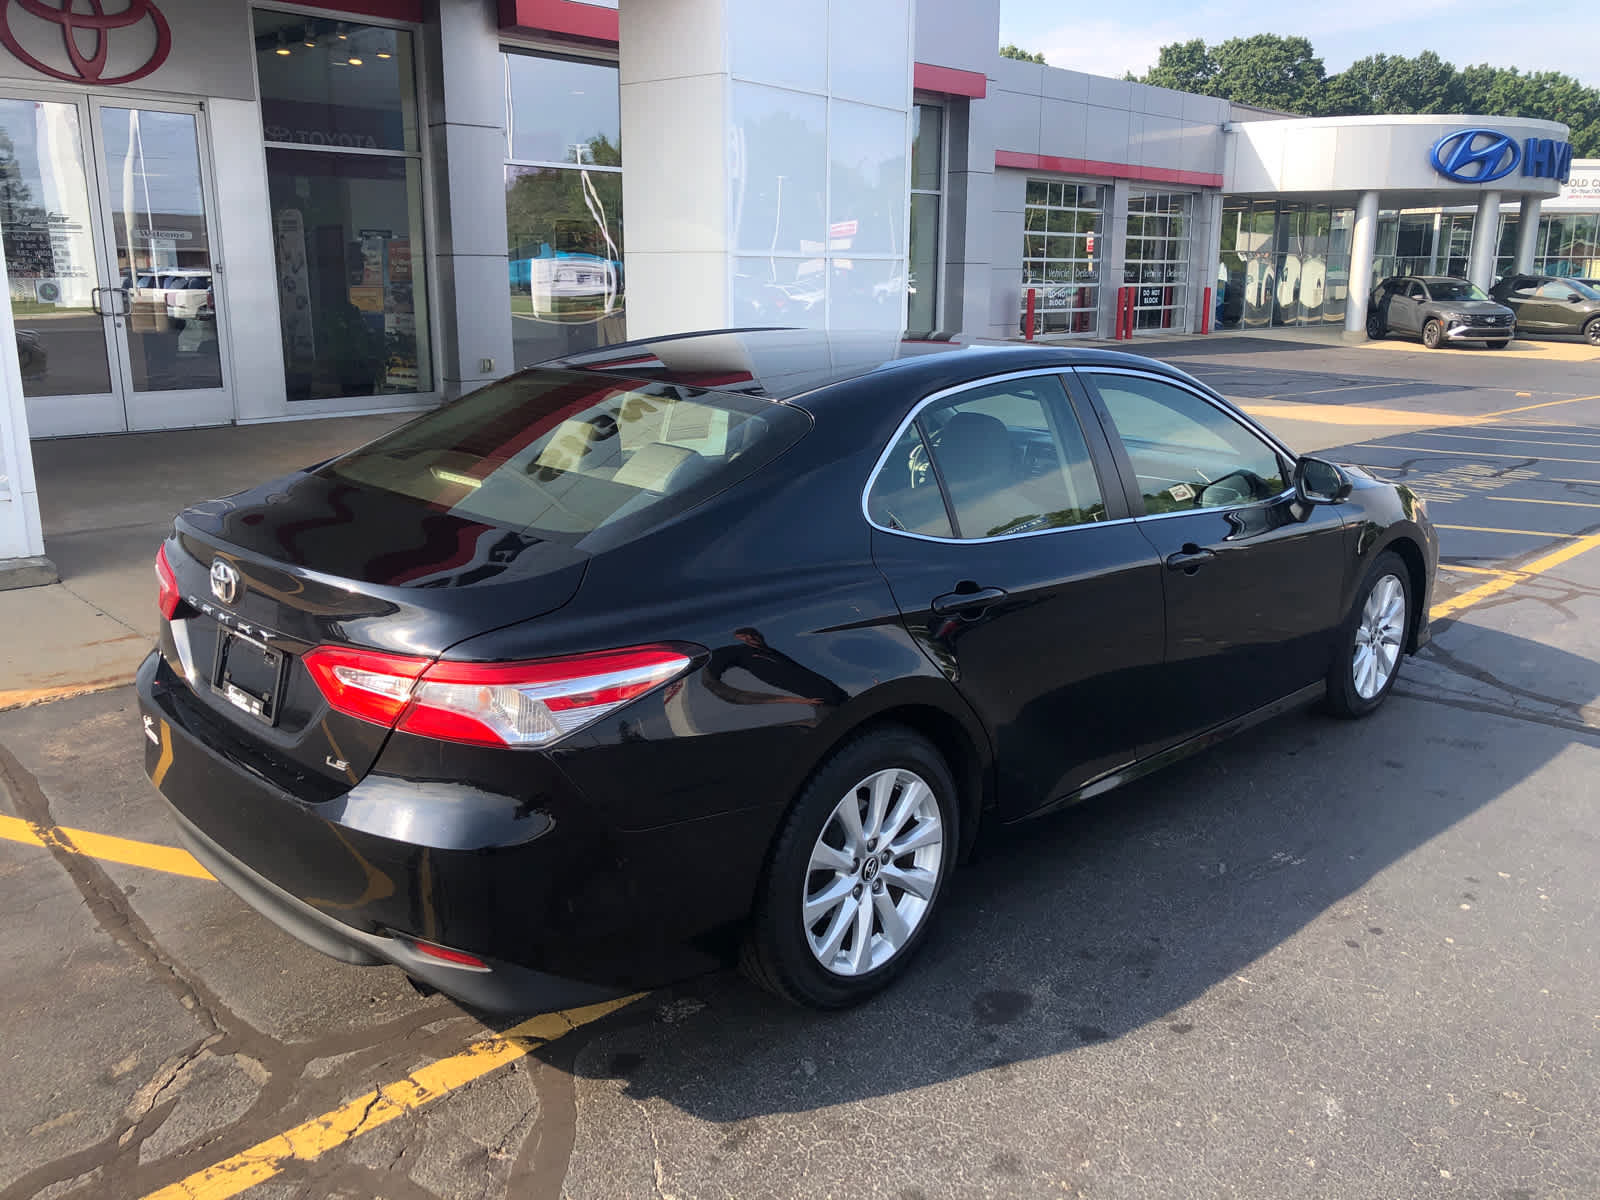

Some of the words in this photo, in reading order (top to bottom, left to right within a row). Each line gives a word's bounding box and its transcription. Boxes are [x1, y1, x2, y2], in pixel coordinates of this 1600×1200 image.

[1562, 178, 1589, 188] OLD
[1048, 299, 1066, 307] BLOCK
[188, 595, 276, 642] CAMRY
[326, 755, 350, 771] LE
